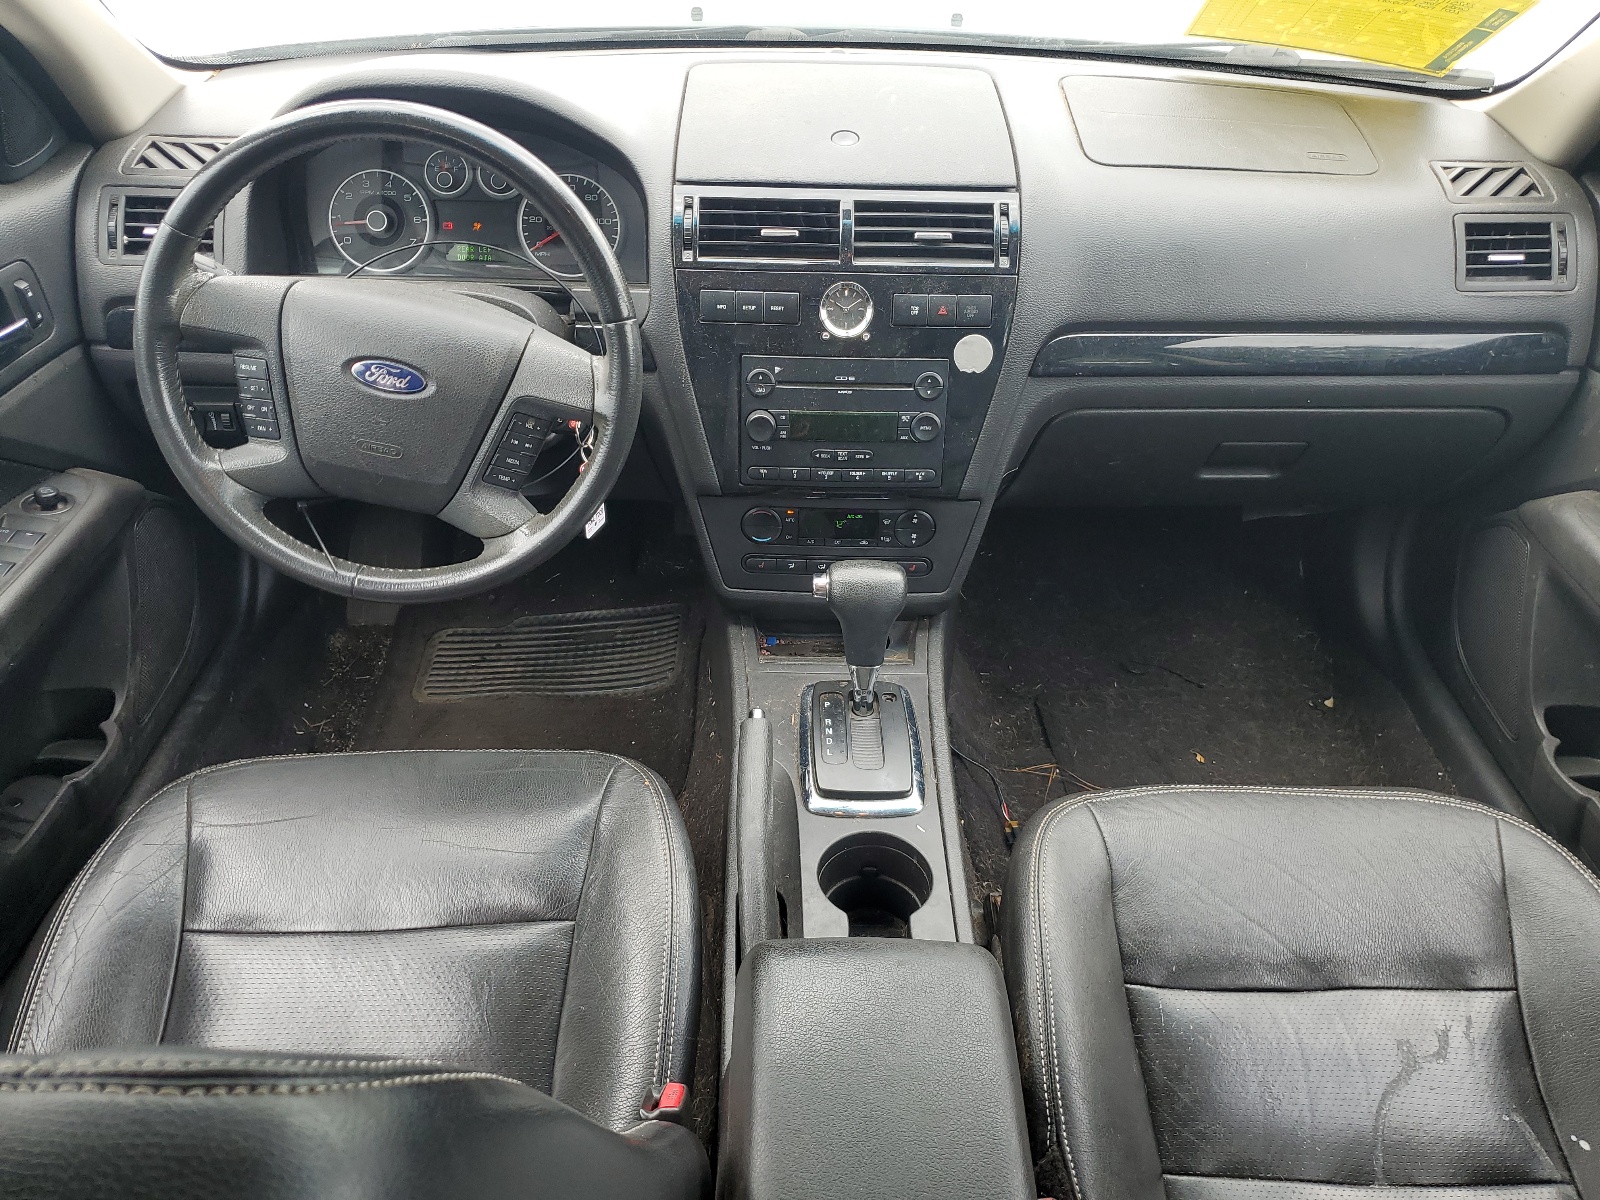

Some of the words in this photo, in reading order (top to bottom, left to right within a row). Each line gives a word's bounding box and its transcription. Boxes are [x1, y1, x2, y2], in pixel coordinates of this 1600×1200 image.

[362, 180, 370, 188] 3
[384, 180, 392, 188] 4
[345, 192, 353, 200] 2
[403, 193, 412, 202] 5
[584, 193, 598, 201] 80
[413, 216, 422, 224] 6
[528, 215, 543, 223] 20
[595, 217, 612, 225] 100
[343, 236, 352, 245] 0
[409, 238, 417, 246] 7
[457, 245, 475, 253] REAR
[240, 363, 257, 371] RESUME
[364, 364, 411, 389] Ford
[498, 474, 511, 482] TEMP
